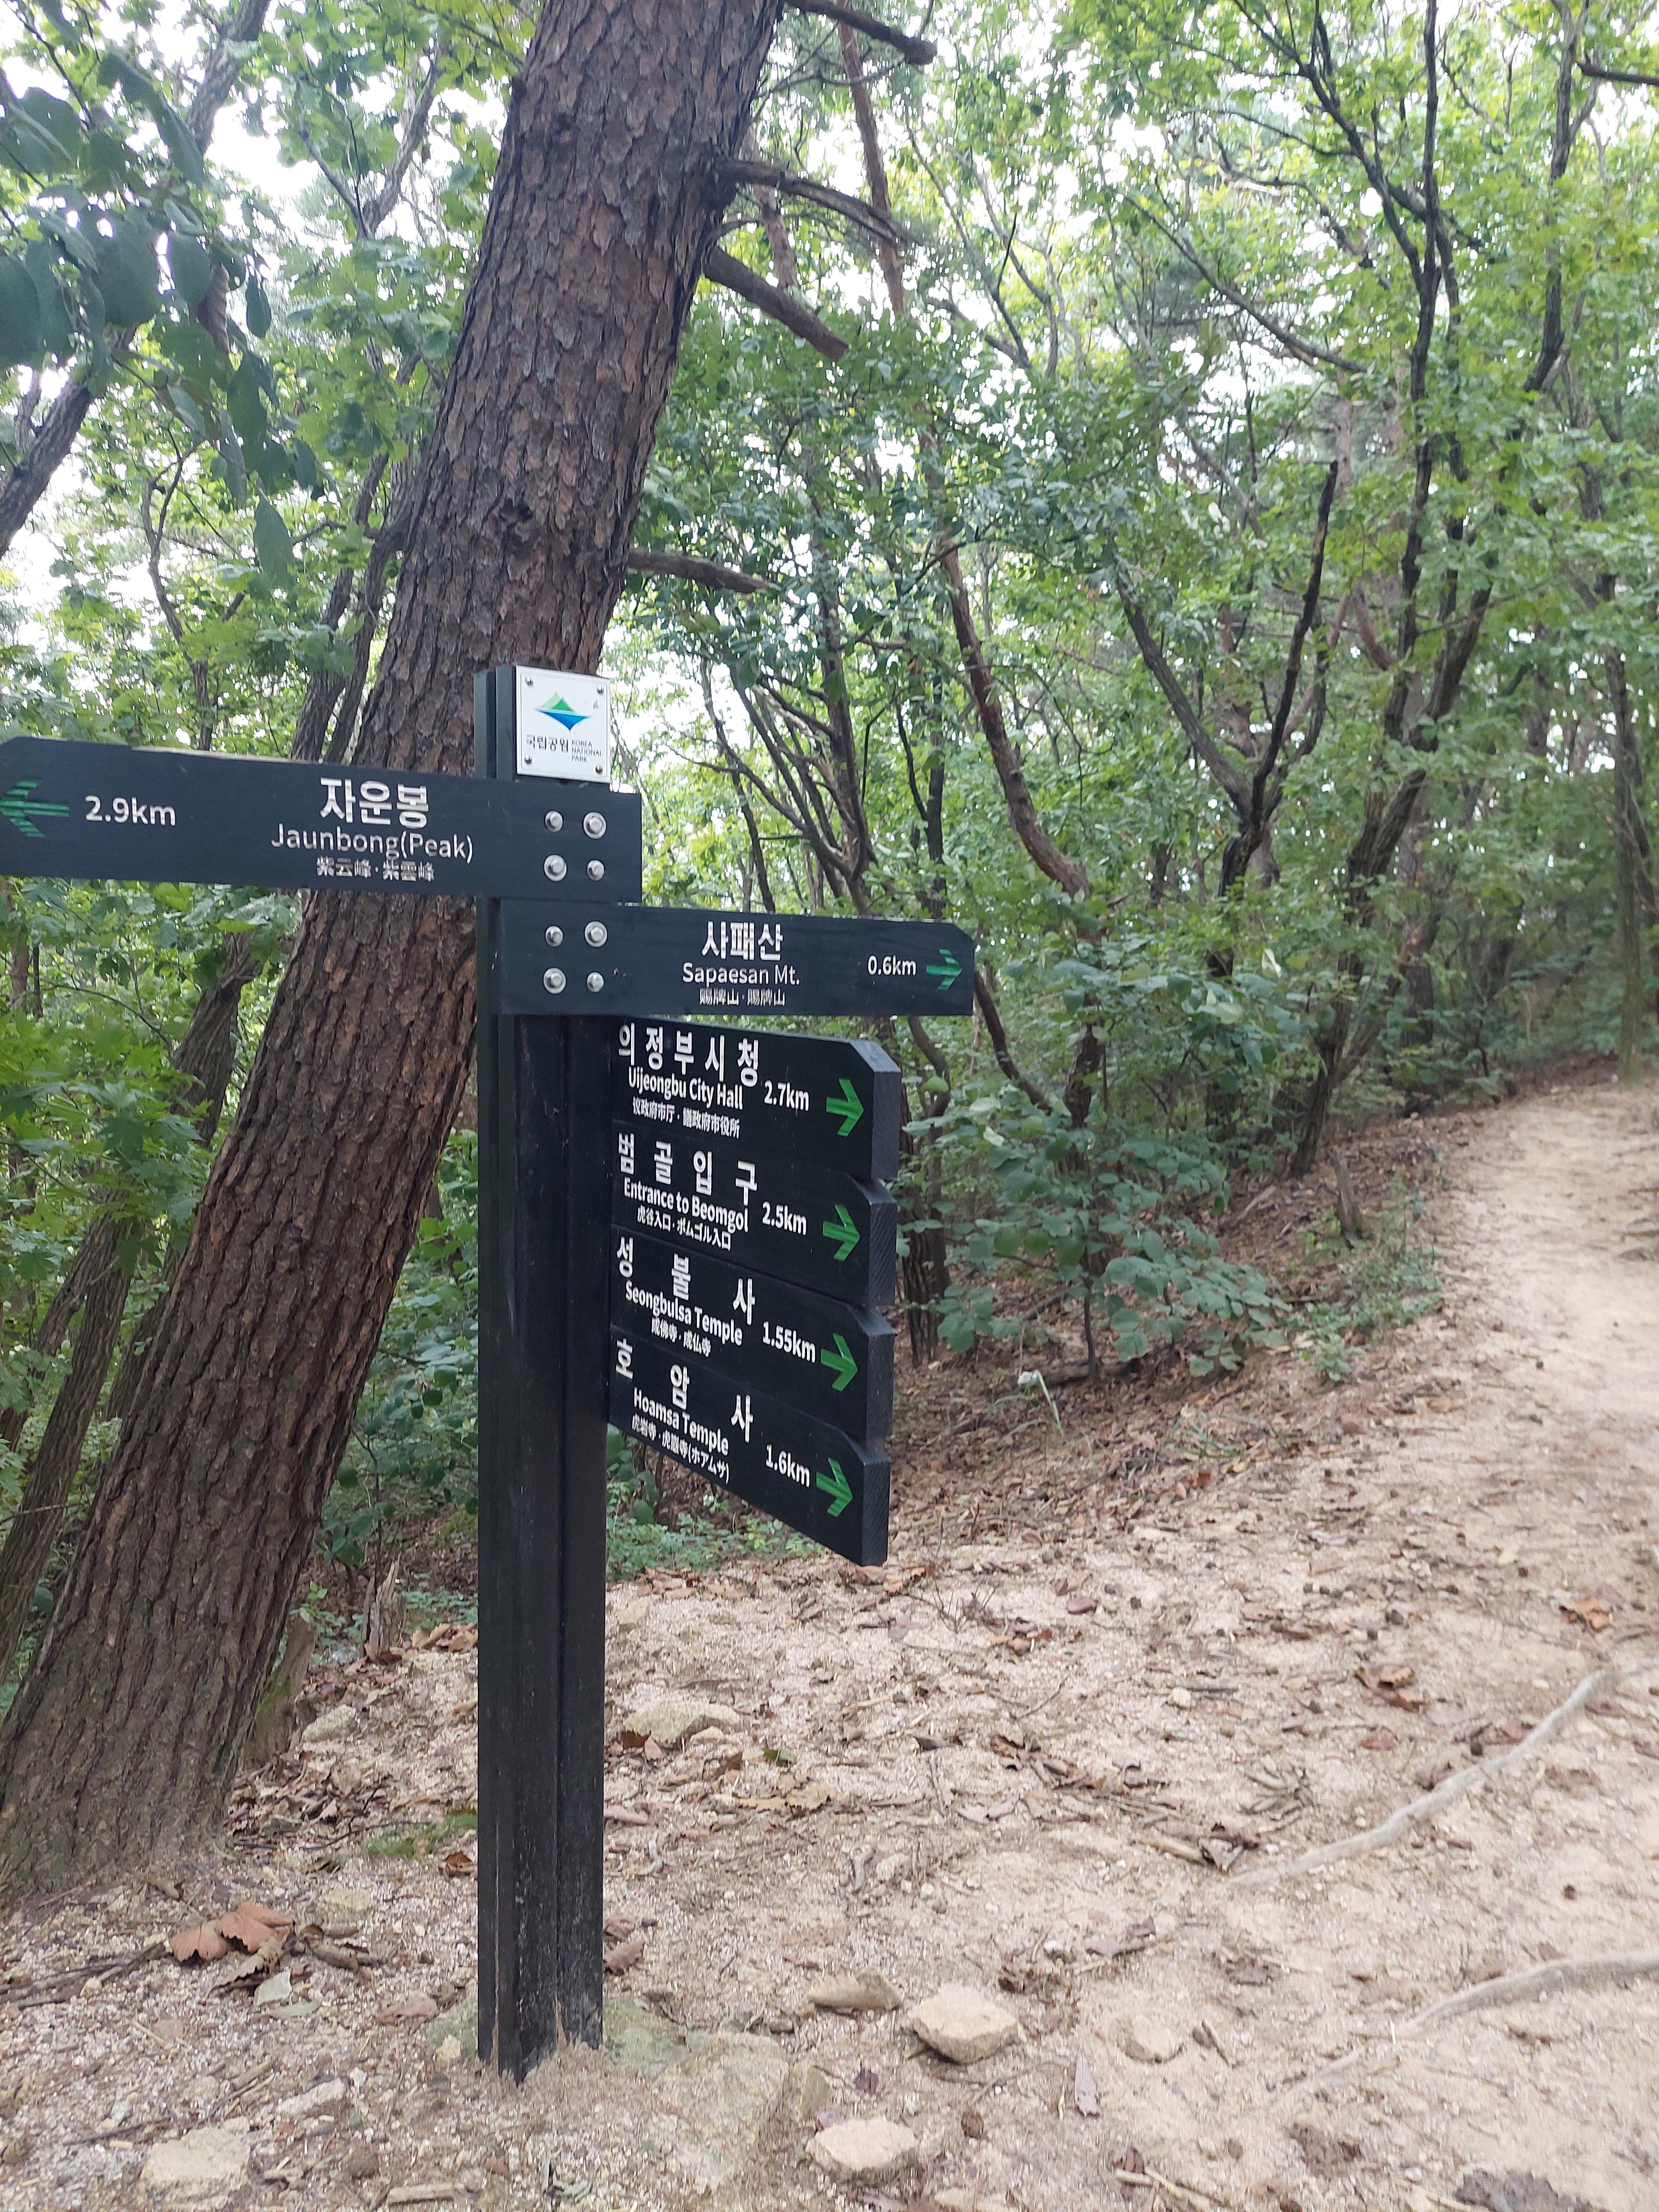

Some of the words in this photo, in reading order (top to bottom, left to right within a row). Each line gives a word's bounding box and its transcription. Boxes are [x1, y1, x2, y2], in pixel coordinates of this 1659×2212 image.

[526, 734, 568, 753] 국립공원
[572, 739, 593, 747] KOREA
[572, 747, 602, 757] NATIONAL
[85, 795, 176, 826] 2.9km
[320, 777, 429, 829] 자운봉
[271, 823, 473, 864] Jaunbong(Peak)
[702, 921, 783, 961] 사패산
[683, 962, 769, 988] Sapaesan
[775, 964, 800, 985] Mt.
[868, 955, 916, 976] 0.6km
[629, 1066, 686, 1101] Uijeongbu
[689, 1078, 714, 1109] City
[717, 1083, 743, 1110] Hall
[764, 1080, 809, 1111] 2.7km
[624, 1176, 674, 1210] Entrance
[676, 1192, 689, 1214] to
[692, 1194, 749, 1234] Beomgol
[762, 1201, 807, 1236] 2.5km
[626, 1281, 692, 1325] Seongbulsa
[694, 1306, 742, 1346] Temple
[763, 1322, 816, 1363] 1.55km
[634, 1387, 679, 1430] Hoamsa
[682, 1411, 729, 1456] Temple
[766, 1444, 810, 1488] 1.6km
